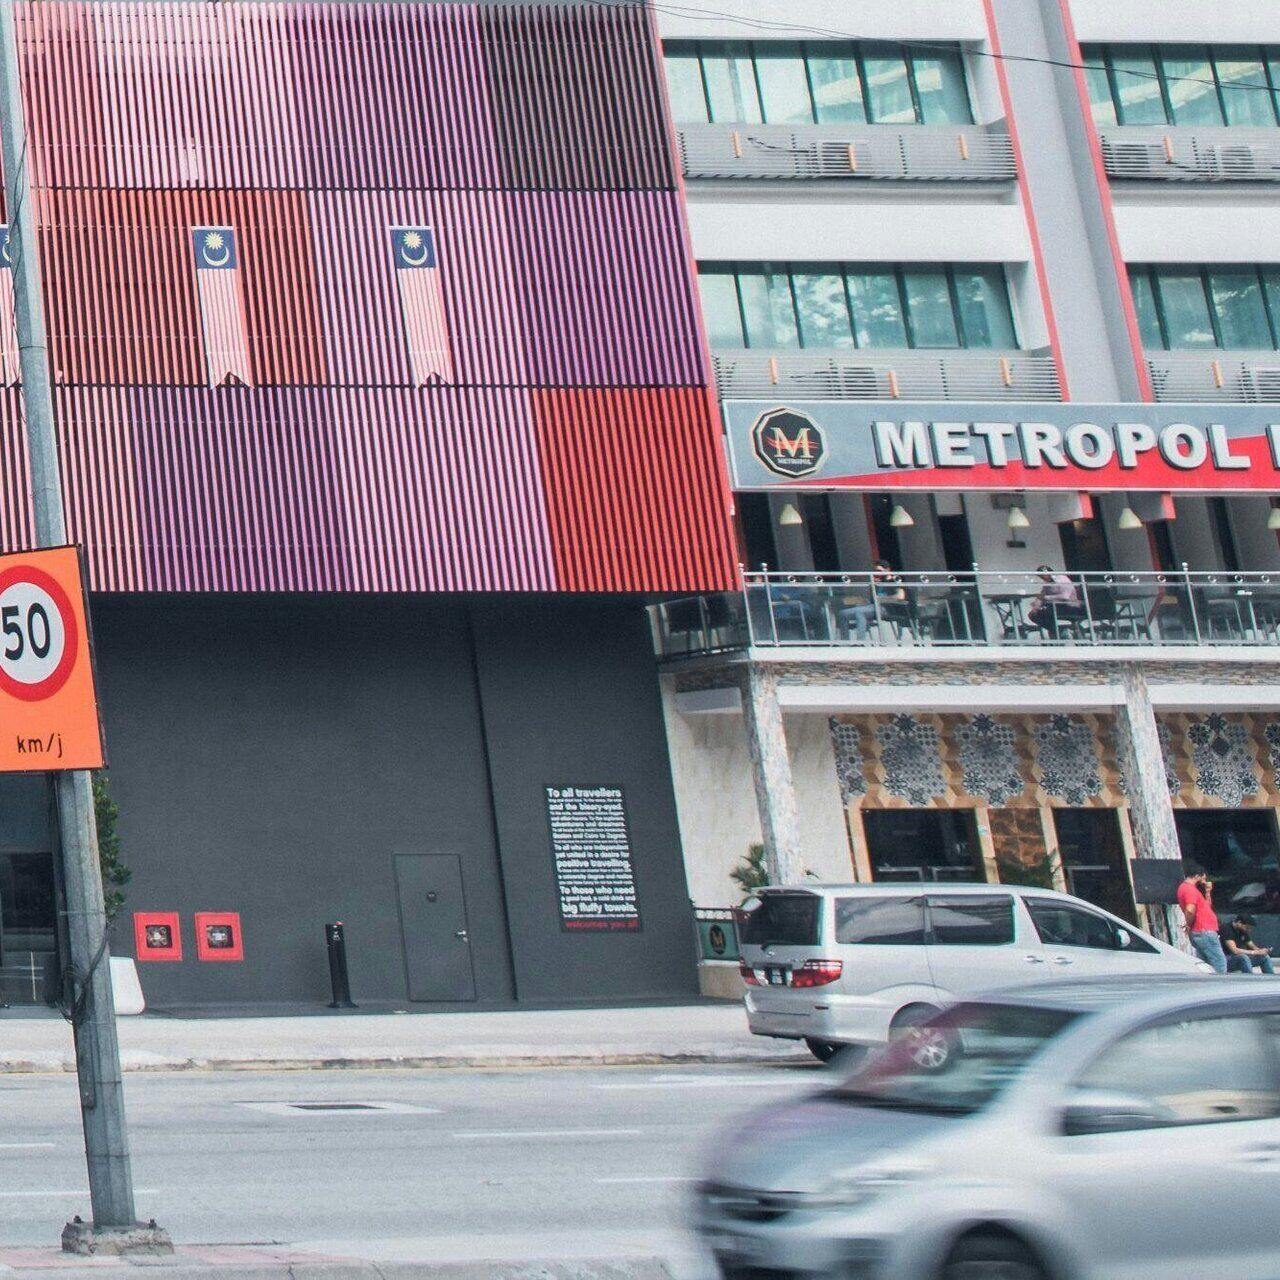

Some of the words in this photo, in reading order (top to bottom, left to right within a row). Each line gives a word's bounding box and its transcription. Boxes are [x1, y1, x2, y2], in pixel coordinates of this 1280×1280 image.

[770, 426, 815, 458] M
[869, 420, 1252, 470] METROPOL
[1, 602, 51, 660] 50
[17, 733, 63, 758] km/j
[546, 787, 560, 798] To
[562, 787, 574, 798] all
[575, 787, 622, 798] travellers
[561, 902, 578, 914] big
[579, 902, 602, 914] fluffy
